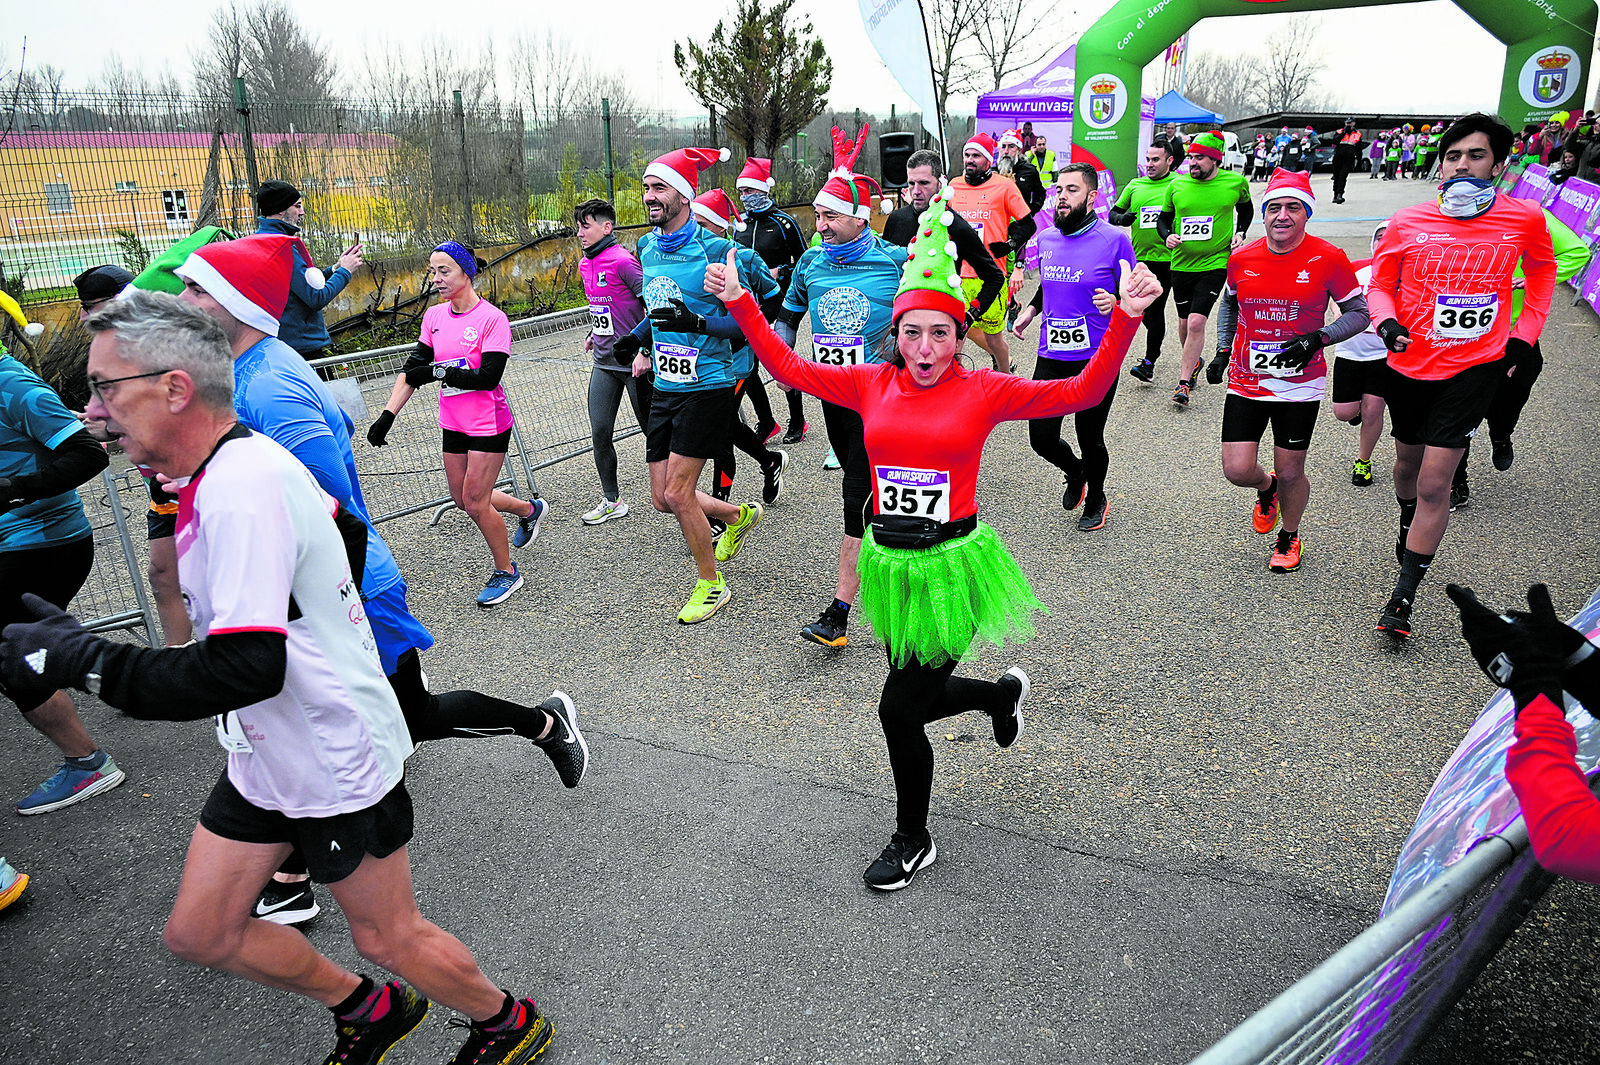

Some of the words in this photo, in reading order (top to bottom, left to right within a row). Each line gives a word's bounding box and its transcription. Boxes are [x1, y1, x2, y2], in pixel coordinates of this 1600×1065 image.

[1117, 31, 1135, 50] Con
[1136, 17, 1146, 30] el
[1147, 0, 1172, 18] depo
[1142, 213, 1159, 223] 22
[1183, 224, 1210, 235] 226
[1413, 243, 1517, 281] GOOD
[1254, 309, 1287, 321] MÁLAGA
[1439, 308, 1494, 329] 366
[1050, 329, 1086, 344] 296
[659, 355, 692, 375] 268
[819, 347, 857, 366] 231
[883, 485, 943, 515] 357
